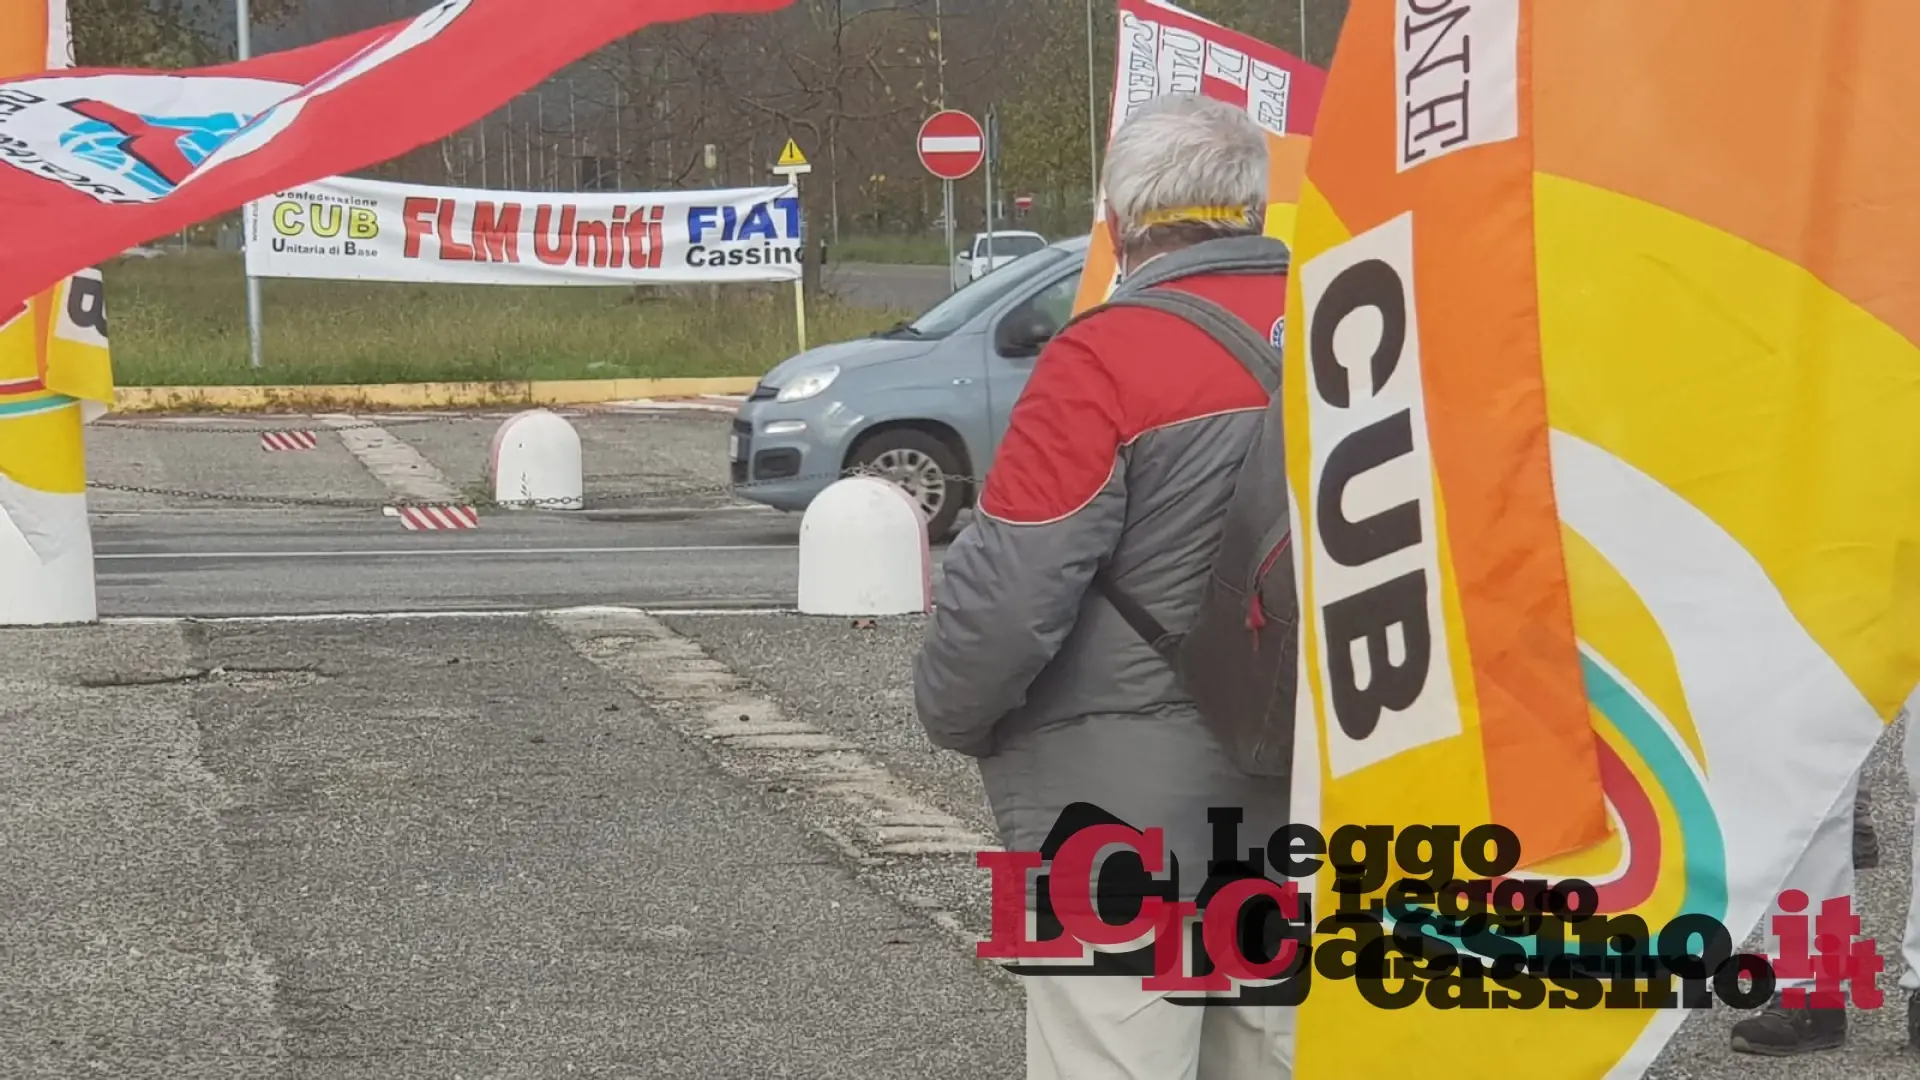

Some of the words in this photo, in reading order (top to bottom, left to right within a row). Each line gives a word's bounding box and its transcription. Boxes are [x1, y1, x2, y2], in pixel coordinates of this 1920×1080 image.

[1404, 0, 1470, 163] NE
[272, 200, 379, 240] CUB
[272, 238, 325, 256] Unitaria
[328, 245, 340, 256] di
[344, 241, 378, 258] Base
[403, 196, 522, 263] FLM
[533, 203, 664, 269] Uniti
[687, 196, 799, 243] FIAT
[1310, 258, 1431, 741] CUB
